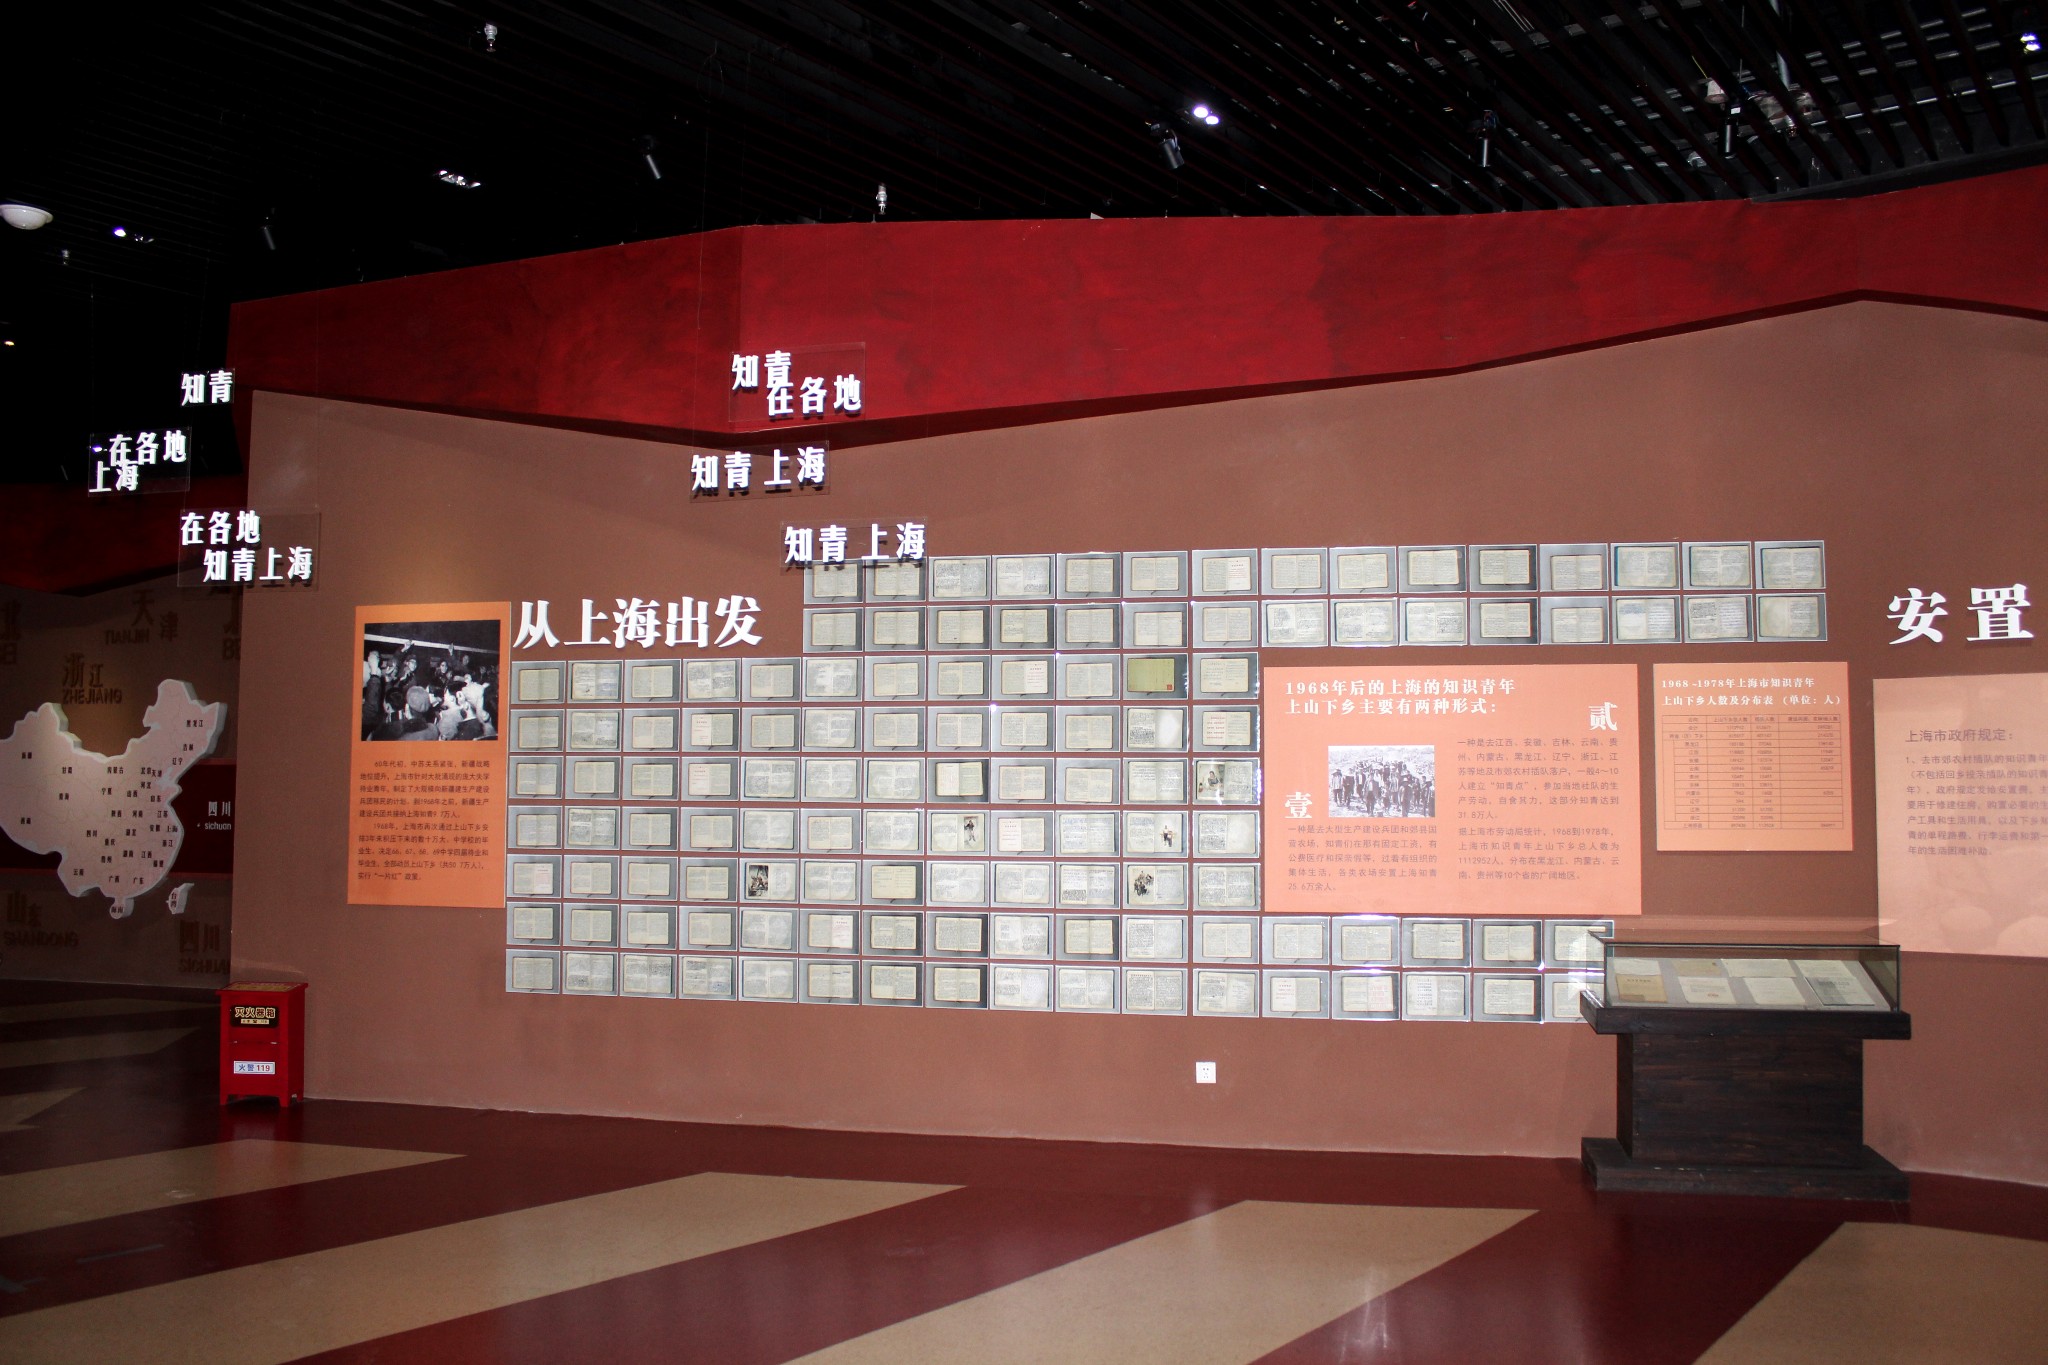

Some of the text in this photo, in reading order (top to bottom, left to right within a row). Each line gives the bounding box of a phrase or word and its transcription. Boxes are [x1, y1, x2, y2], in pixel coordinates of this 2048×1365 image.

[731, 350, 793, 390] 知青
[181, 370, 234, 406] 知青
[766, 374, 861, 416] 在各地
[109, 430, 187, 467] 在各地
[89, 459, 139, 492] 上海
[691, 446, 825, 491] 知青 上海
[181, 510, 261, 545] 在各地
[784, 522, 925, 564] 知青 上海
[203, 546, 312, 583] 知青上海
[513, 595, 763, 649] 从上海出发
[1887, 583, 2034, 645] 安置
[62, 688, 122, 705] ZHEJIANG
[1285, 678, 1515, 696] 1968年后的上海的知识青年
[1285, 698, 1497, 716] 上山下乡主要有两种形式：
[1588, 702, 1618, 731] 贰
[1905, 729, 2013, 743] 上海市政府规定：
[208, 801, 231, 817] 四川
[1284, 792, 1313, 819] 壹
[204, 822, 231, 830] sichuan
[235, 1006, 276, 1019] 灭火器箱
[238, 1063, 270, 1072] 火警 119
